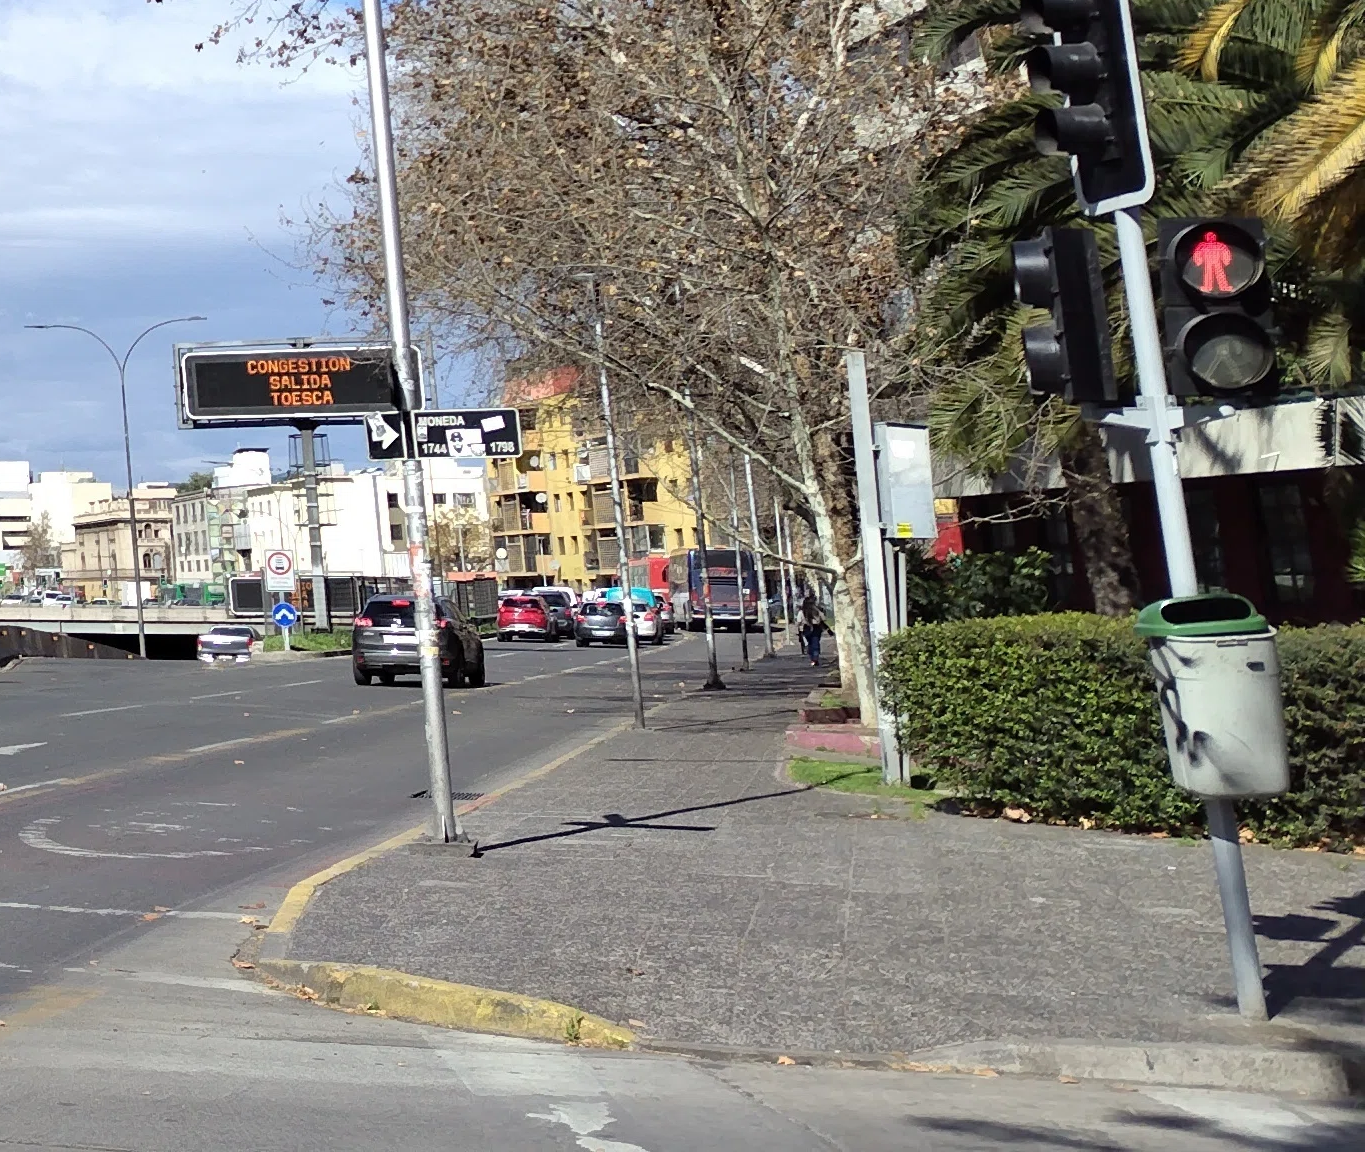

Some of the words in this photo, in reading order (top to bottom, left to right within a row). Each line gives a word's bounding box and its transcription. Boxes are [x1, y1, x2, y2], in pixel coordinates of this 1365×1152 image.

[247, 357, 351, 374] CONGESTION
[269, 374, 332, 389] SALIDA
[271, 390, 334, 406] TOESCA
[417, 415, 466, 427] MONEDA
[421, 443, 448, 454] 1744
